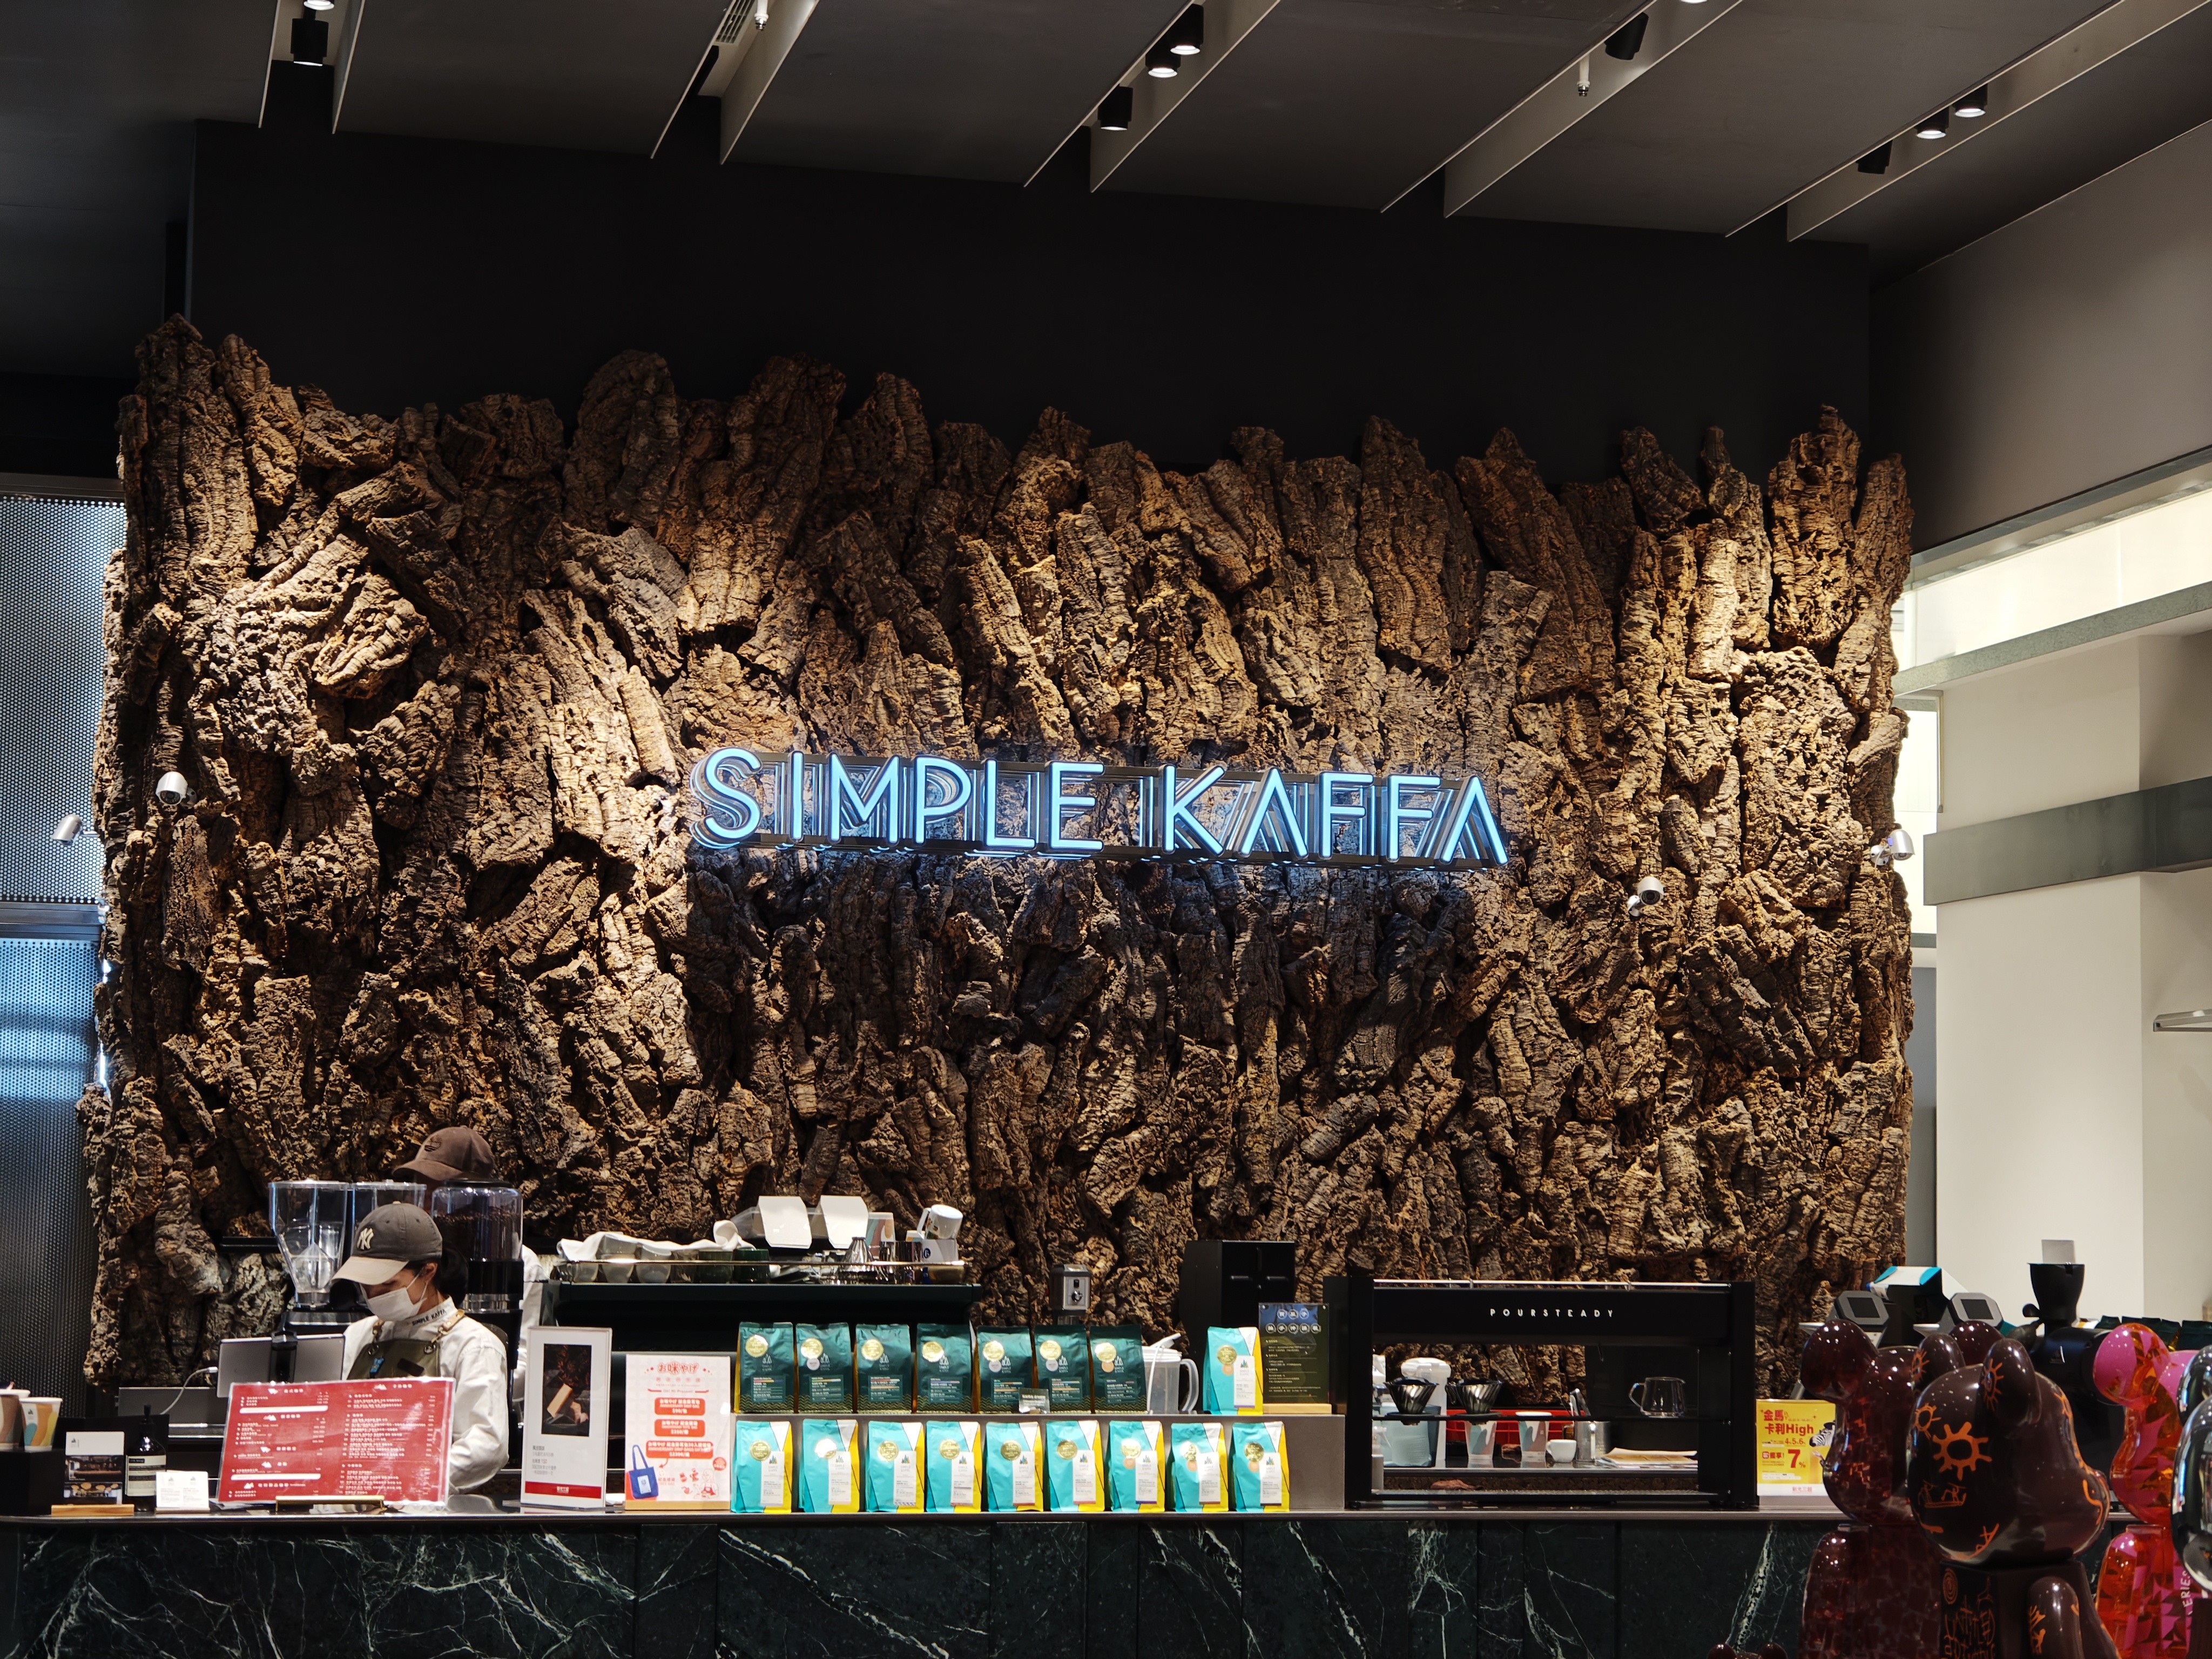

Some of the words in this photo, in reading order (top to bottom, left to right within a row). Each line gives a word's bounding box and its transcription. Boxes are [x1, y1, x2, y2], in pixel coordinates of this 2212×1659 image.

[693, 746, 1104, 853] SIMPLE
[1159, 764, 1509, 865] KAFFA
[1490, 1308, 1613, 1318] POURSTEADY
[412, 1316, 429, 1326] SIMPLE
[1764, 1410, 1784, 1421] 金馬
